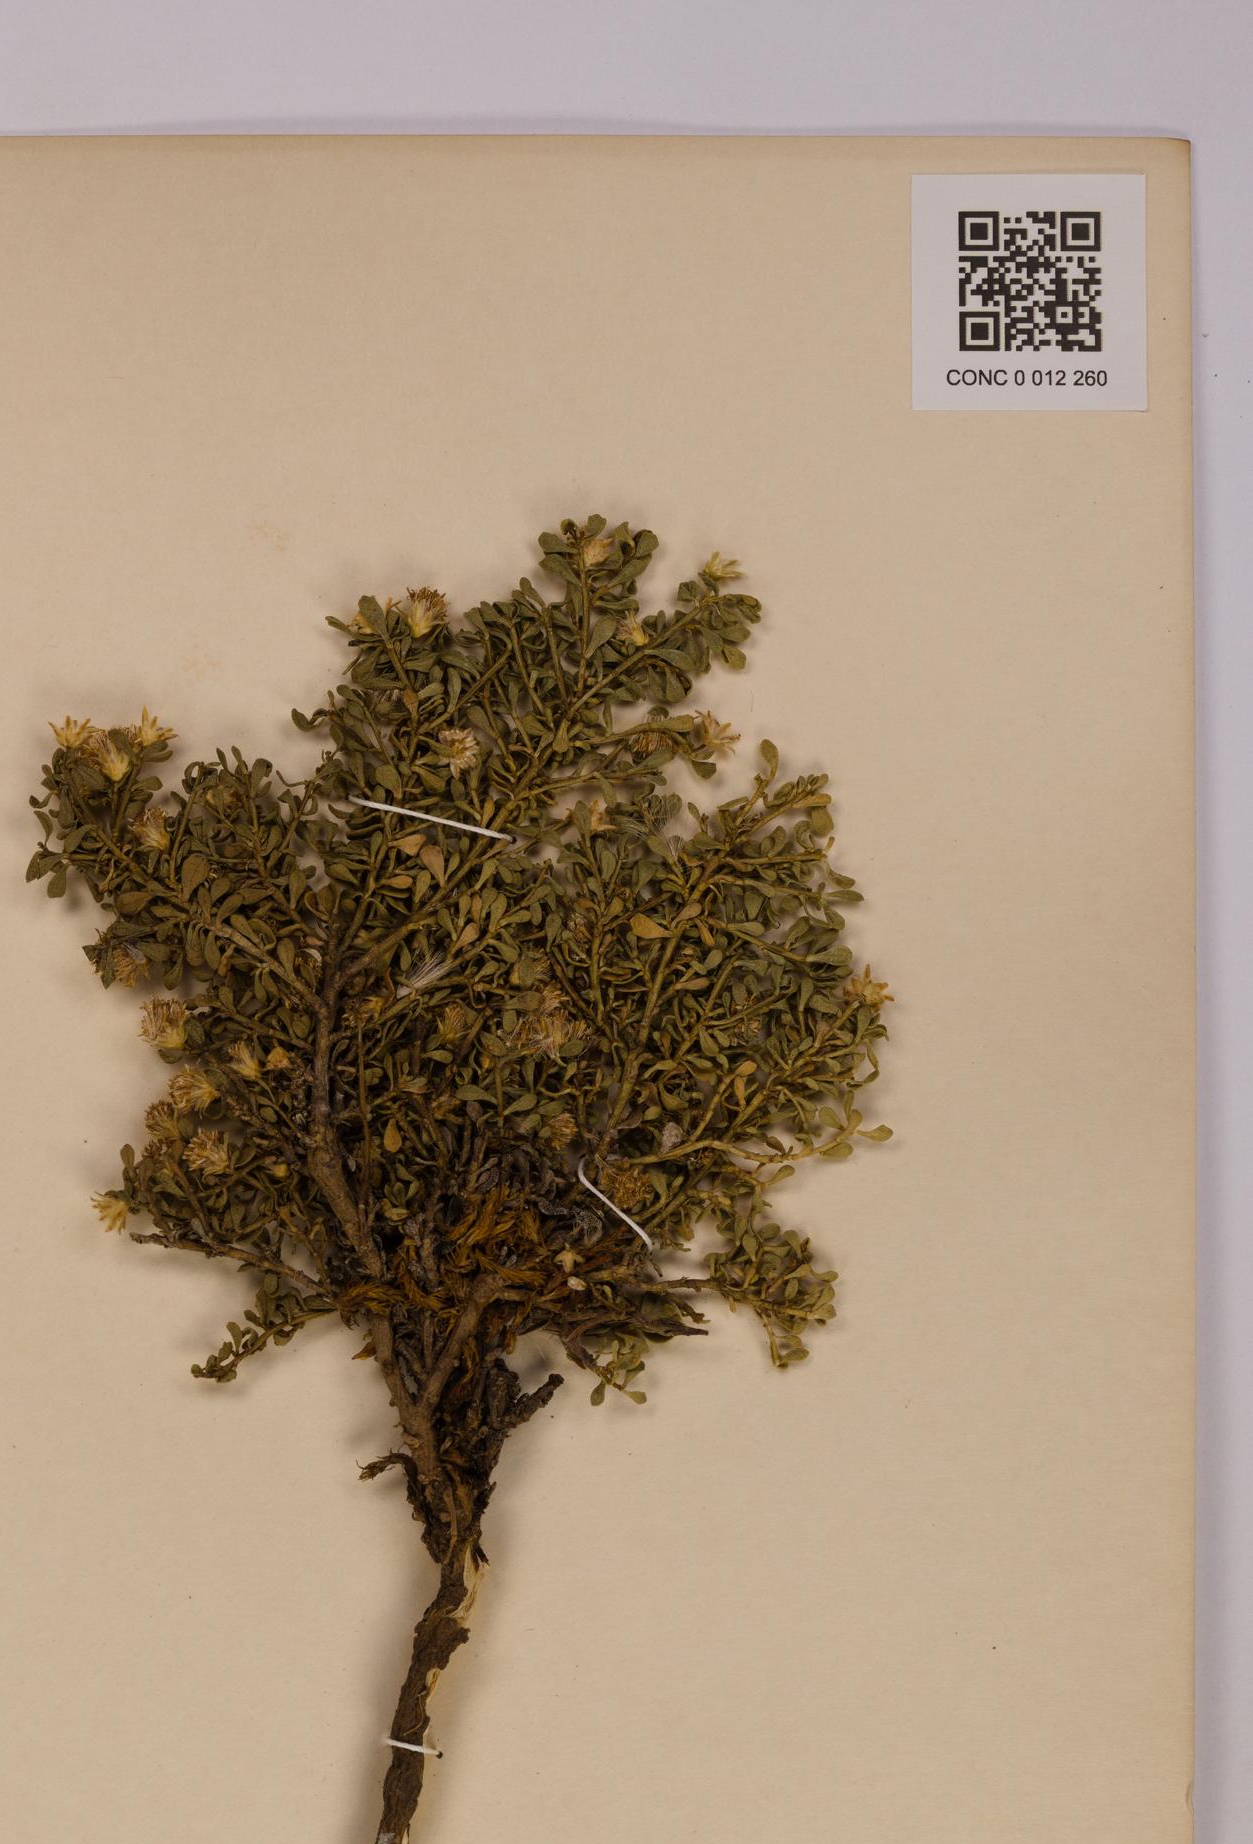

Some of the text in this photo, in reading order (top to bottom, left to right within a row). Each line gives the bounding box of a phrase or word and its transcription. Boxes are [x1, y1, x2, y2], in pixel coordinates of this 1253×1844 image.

[946, 369, 1108, 387] CONC 0 012 260
